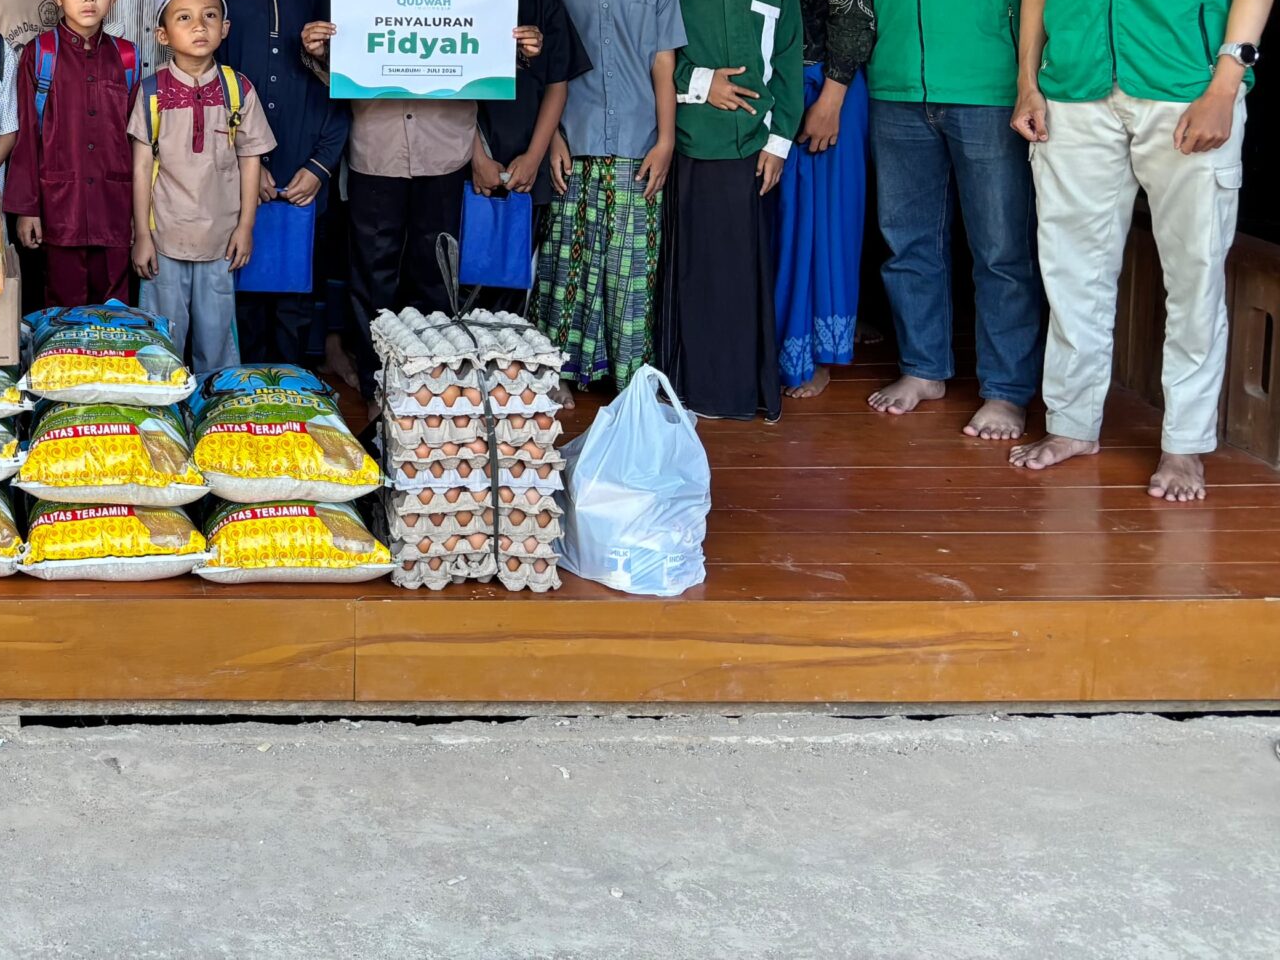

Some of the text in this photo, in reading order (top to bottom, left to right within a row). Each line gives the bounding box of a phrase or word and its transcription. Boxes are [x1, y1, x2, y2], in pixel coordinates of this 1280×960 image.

[375, 17, 474, 27] PENYALURAN
[367, 29, 480, 59] Fidyah
[80, 348, 125, 357] TERJAMIN
[76, 424, 131, 436] TERJAMIN
[249, 422, 301, 435] TERJAMIN
[75, 506, 128, 518] TERJAMIN
[207, 505, 309, 540] KWALITAS TERJAMIN
